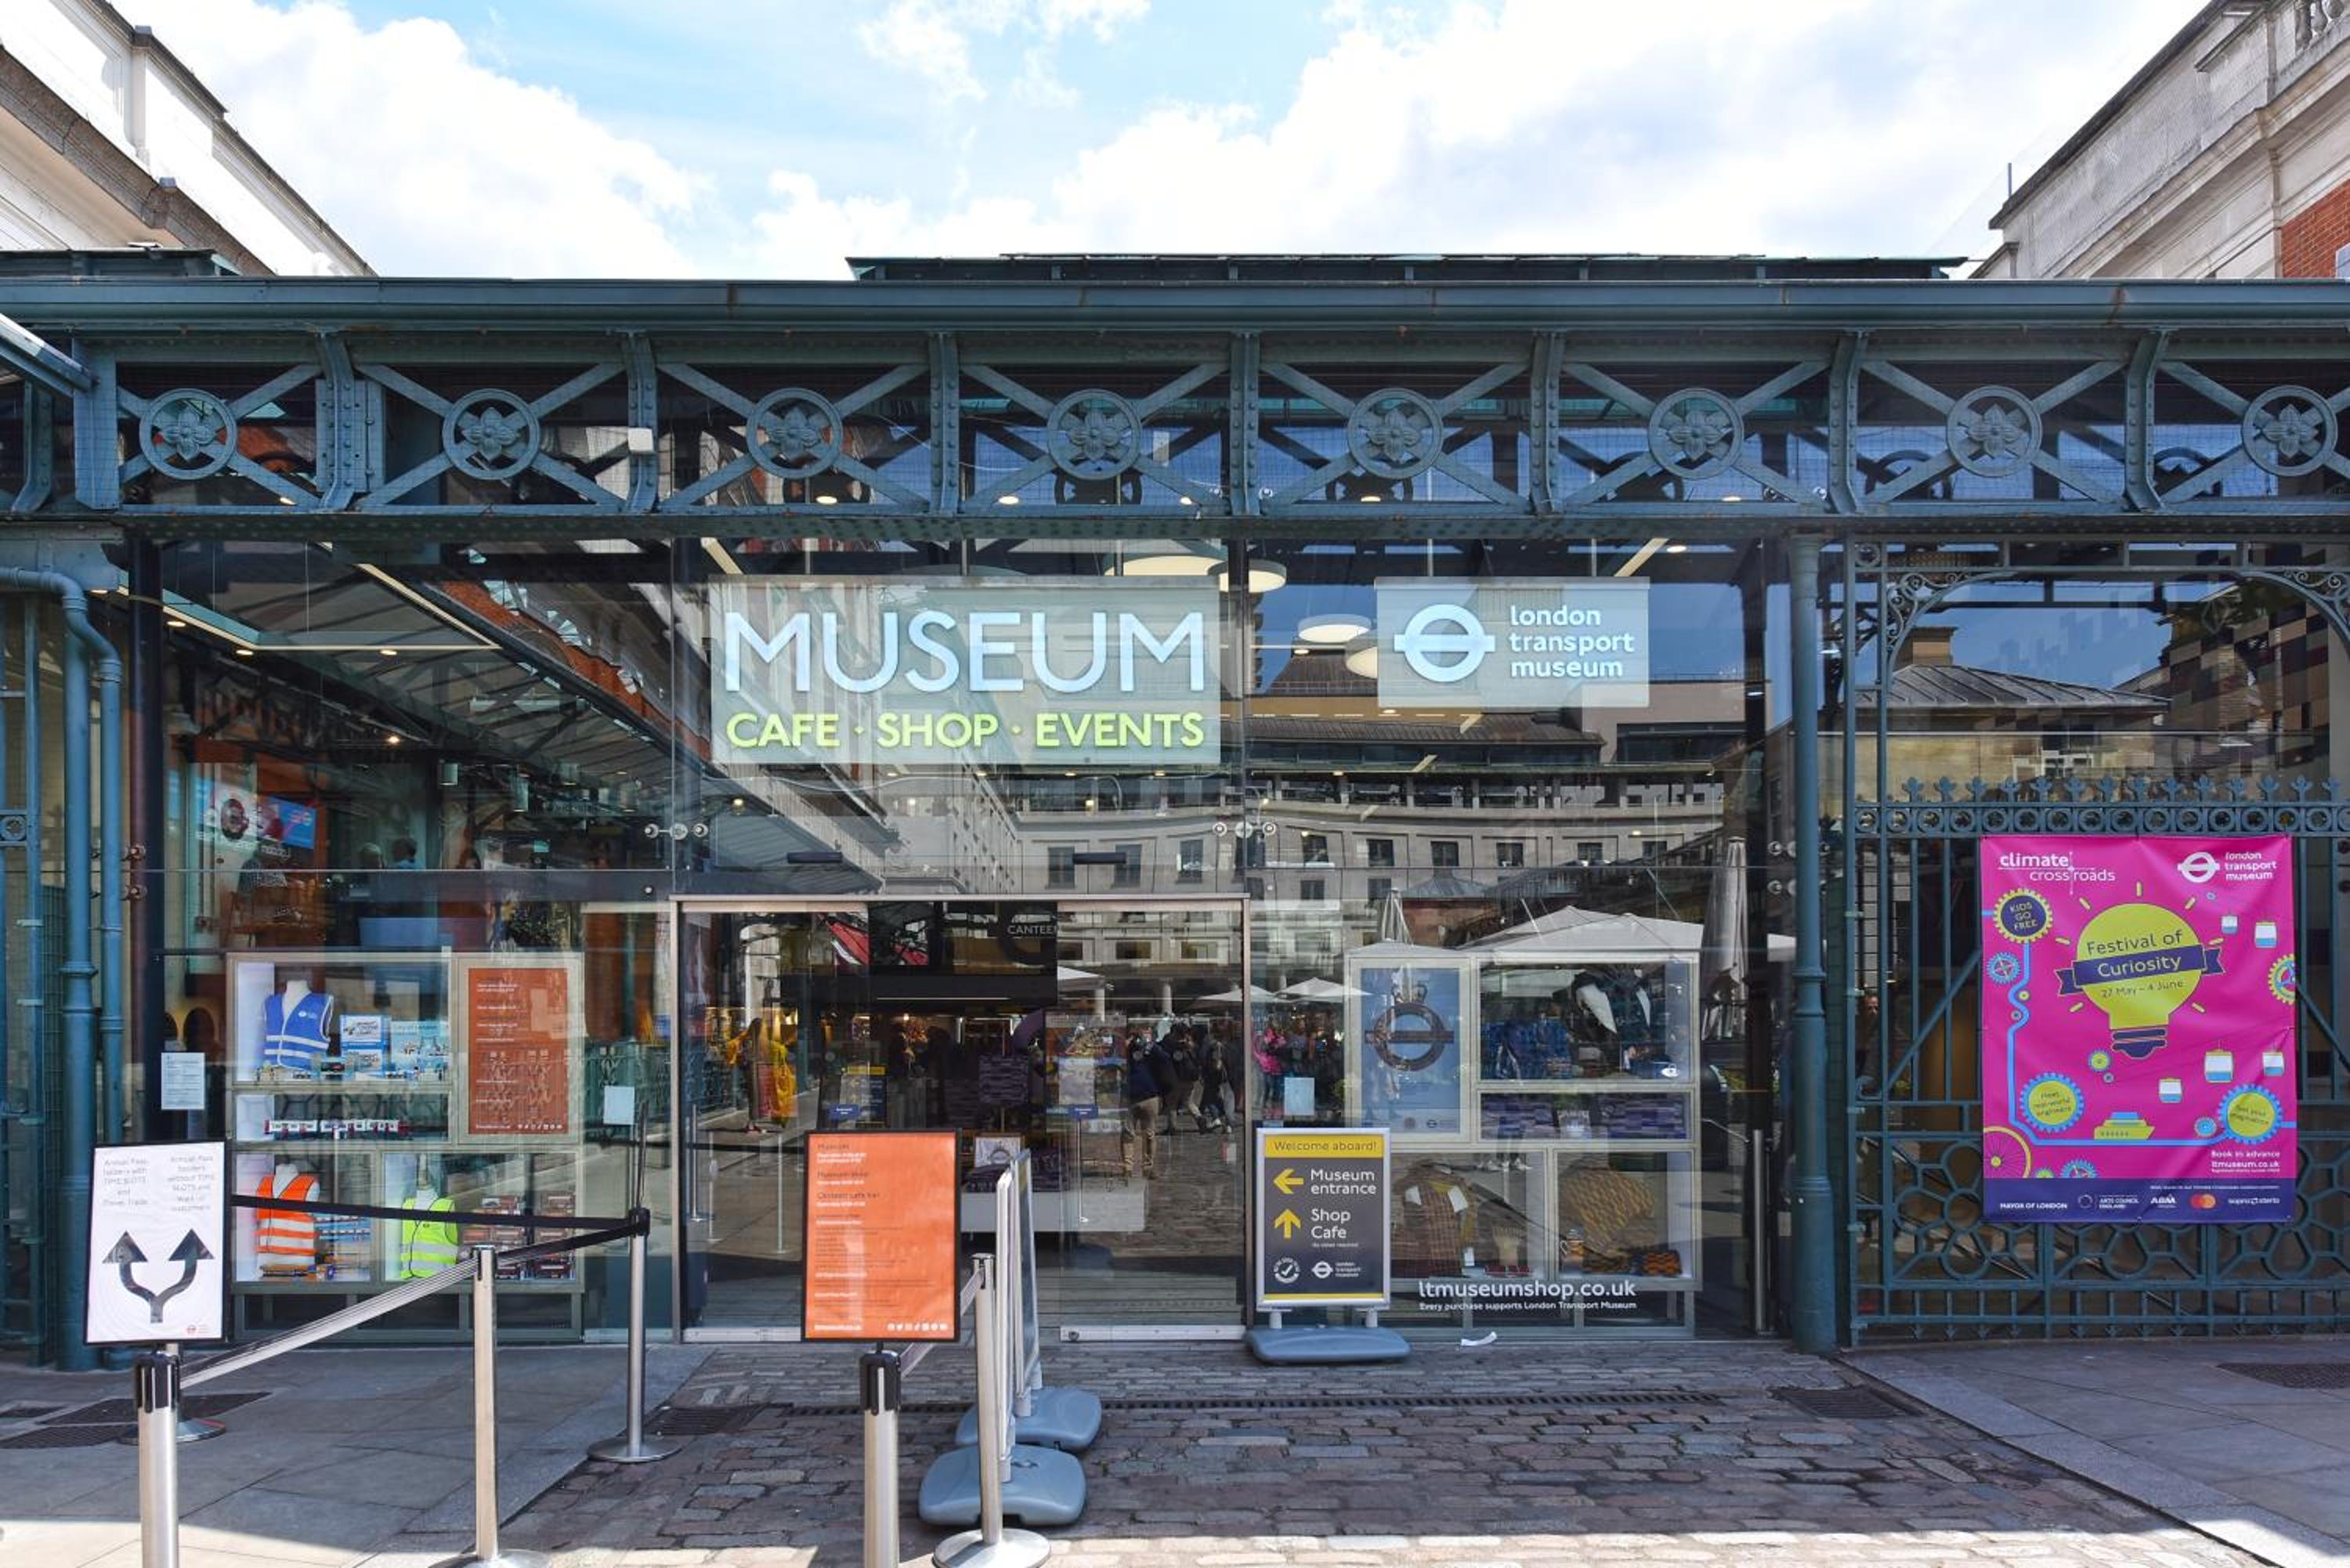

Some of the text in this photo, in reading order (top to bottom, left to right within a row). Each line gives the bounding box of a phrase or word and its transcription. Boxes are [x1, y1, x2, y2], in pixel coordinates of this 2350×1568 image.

[1509, 605, 1601, 627] london
[1509, 633, 1635, 656] transport
[725, 611, 1204, 692] MUSEUM
[1511, 661, 1623, 677] museum
[726, 712, 1205, 748] CAFE SHOP EVENTS
[1999, 851, 2070, 867] climate
[2225, 851, 2262, 861] london
[2224, 861, 2277, 872] transport
[2225, 871, 2273, 881] museum
[2009, 901, 2033, 912] KIDS
[2015, 912, 2031, 921] GO
[2014, 919, 2037, 930] FREE
[2087, 930, 2182, 956] Festival of
[2097, 956, 2182, 977] Curiosity
[1274, 1140, 1377, 1151] Welcome aboard!
[1311, 1169, 1375, 1181] Museum
[1311, 1183, 1376, 1194] entrance
[1311, 1209, 1351, 1223] Shop
[1311, 1226, 1347, 1239] Cafe
[1419, 1280, 1636, 1299] ltmuseumshop.co.uk
[1419, 1302, 1443, 1312] Every
[1444, 1302, 1483, 1312] purchase
[1485, 1302, 1522, 1311] supports
[1524, 1301, 1556, 1310] London
[1559, 1301, 1598, 1311] Transport
